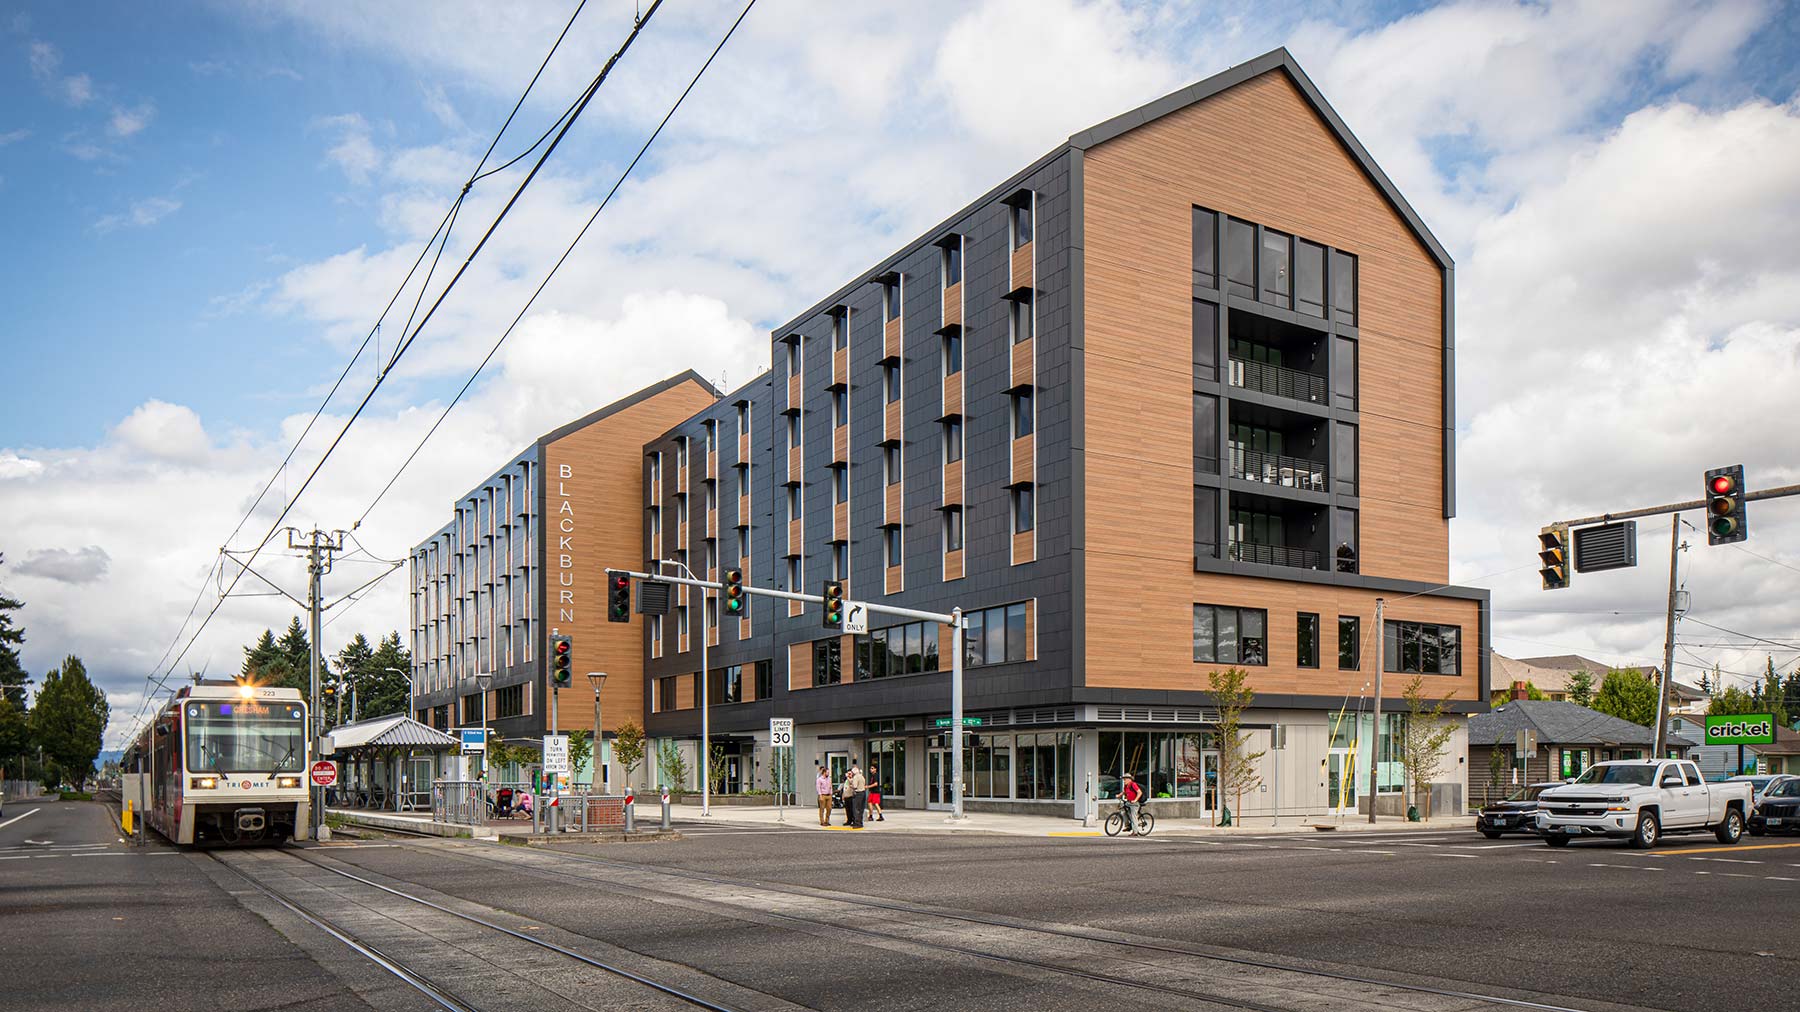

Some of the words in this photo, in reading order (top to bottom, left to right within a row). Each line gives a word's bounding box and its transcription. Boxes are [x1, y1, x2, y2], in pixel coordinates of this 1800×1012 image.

[559, 464, 574, 622] BLACKBURN
[1709, 721, 1770, 737] cricket
[553, 738, 559, 746] U
[773, 732, 791, 744] 30
